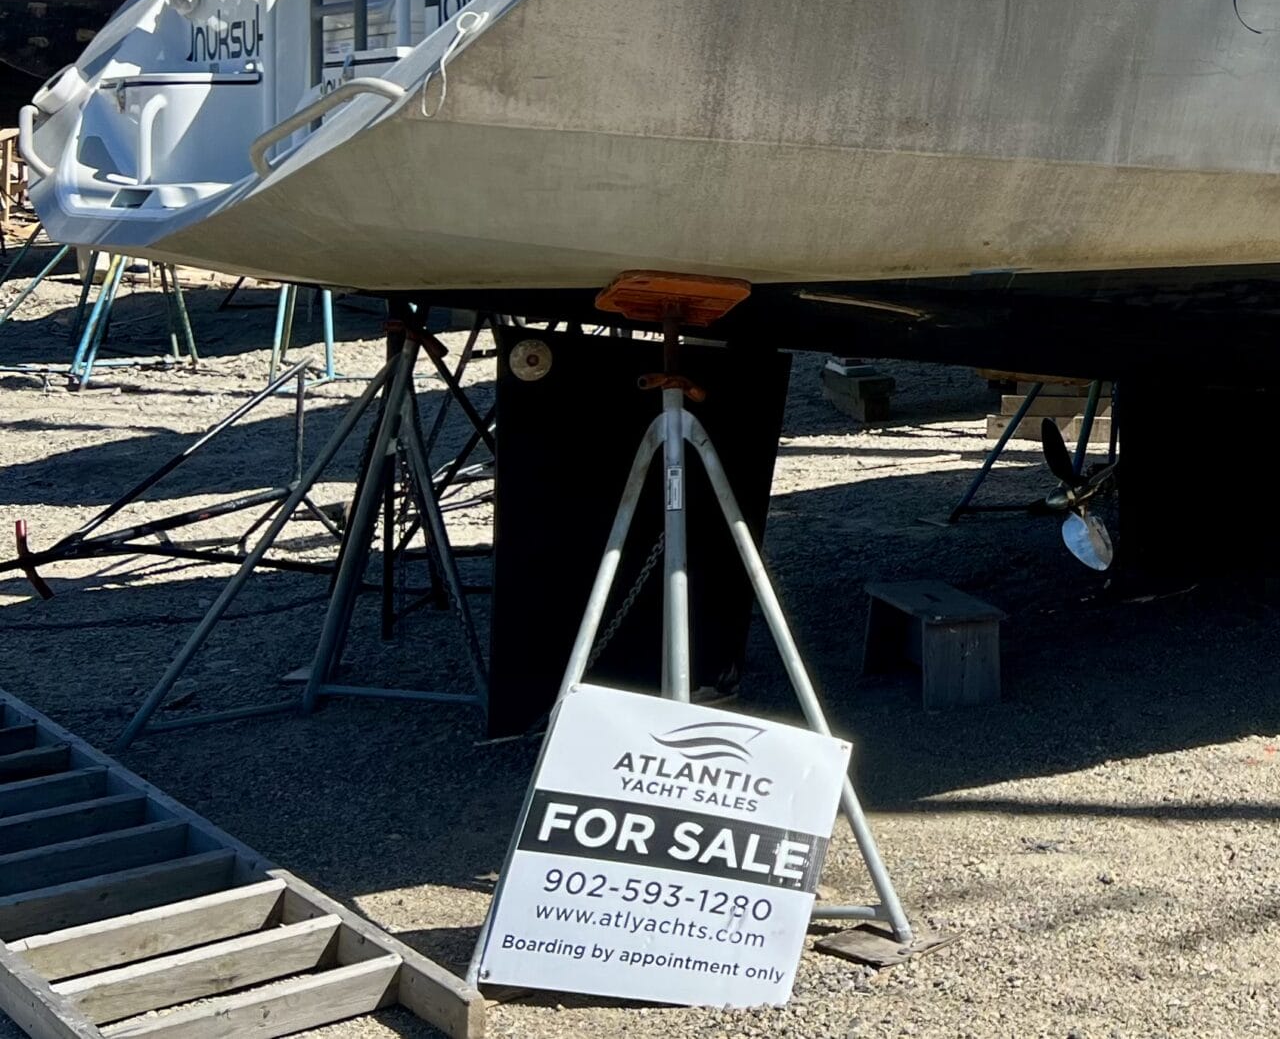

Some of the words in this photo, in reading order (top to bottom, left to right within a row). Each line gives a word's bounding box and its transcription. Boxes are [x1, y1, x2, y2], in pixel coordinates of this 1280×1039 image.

[613, 751, 774, 797] ATLANTIC
[620, 777, 685, 801] YACHT
[693, 789, 759, 813] SALES
[537, 802, 656, 854] FOR
[667, 821, 811, 881] SALE
[543, 868, 773, 922] 902-593-1280
[535, 903, 766, 948] www.atlyachts.com
[501, 934, 586, 960] Boarding
[591, 944, 615, 963] by
[619, 948, 740, 977] appointment
[745, 965, 785, 984] only
